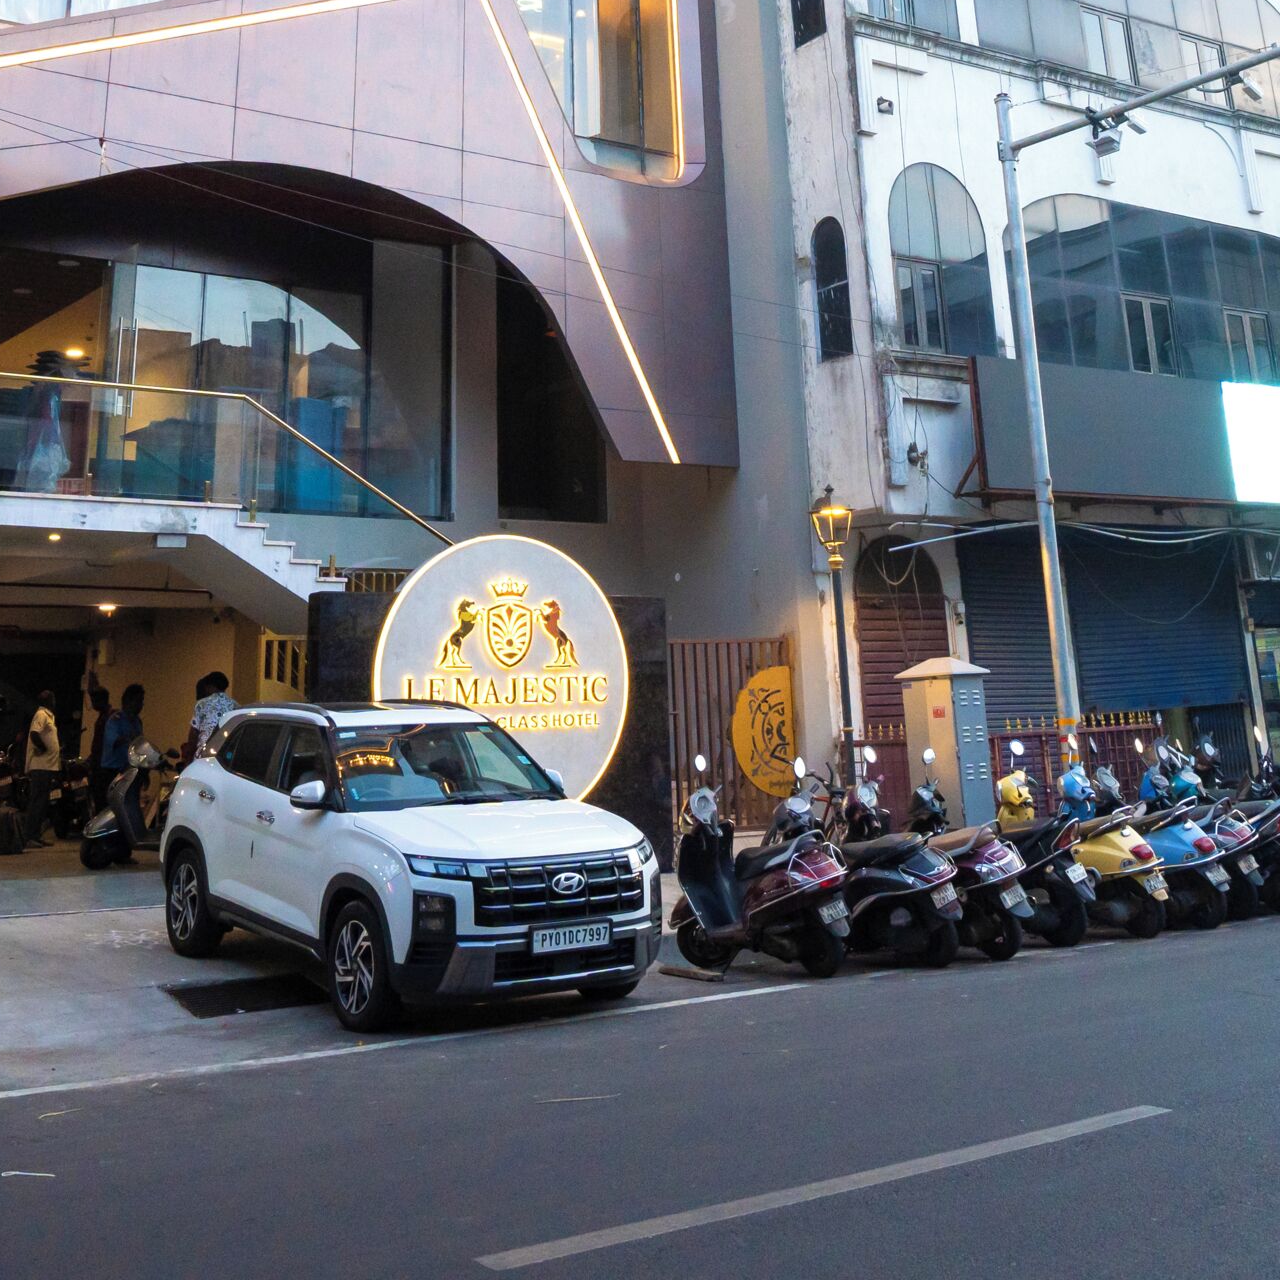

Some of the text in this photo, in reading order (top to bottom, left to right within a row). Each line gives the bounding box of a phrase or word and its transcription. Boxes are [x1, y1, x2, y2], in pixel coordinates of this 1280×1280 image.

[407, 676, 608, 705] LE MAJESTIC
[496, 713, 601, 730] CLASS HOTEL
[541, 926, 608, 948] PY01DC7997
